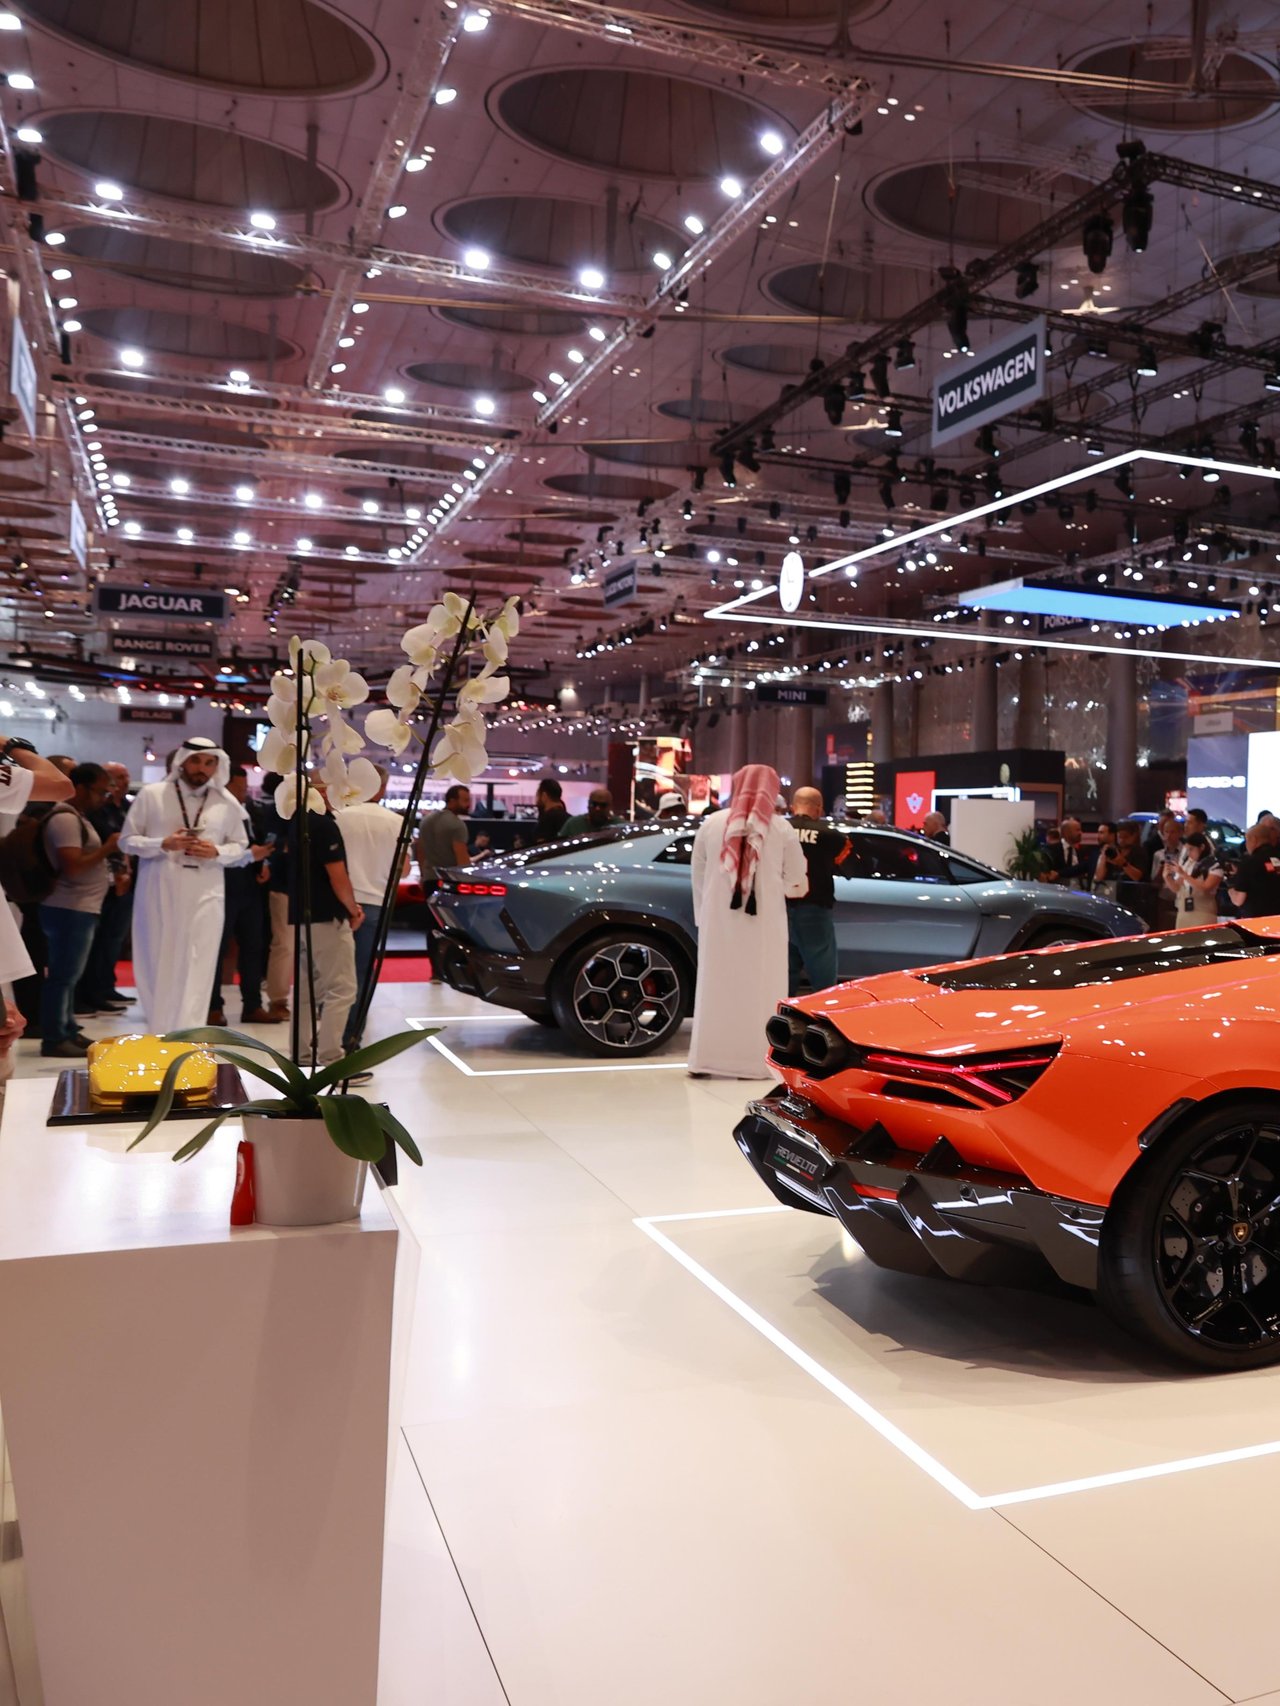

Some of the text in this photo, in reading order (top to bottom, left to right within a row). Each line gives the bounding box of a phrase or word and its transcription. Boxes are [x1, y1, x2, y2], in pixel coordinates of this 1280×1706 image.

[938, 346, 1036, 417] VOLKSWAGEN
[118, 593, 203, 612] JAGUAR
[114, 638, 211, 654] RANGE ROVER
[777, 689, 807, 701] MINI
[774, 1144, 820, 1175] REVUELTO
